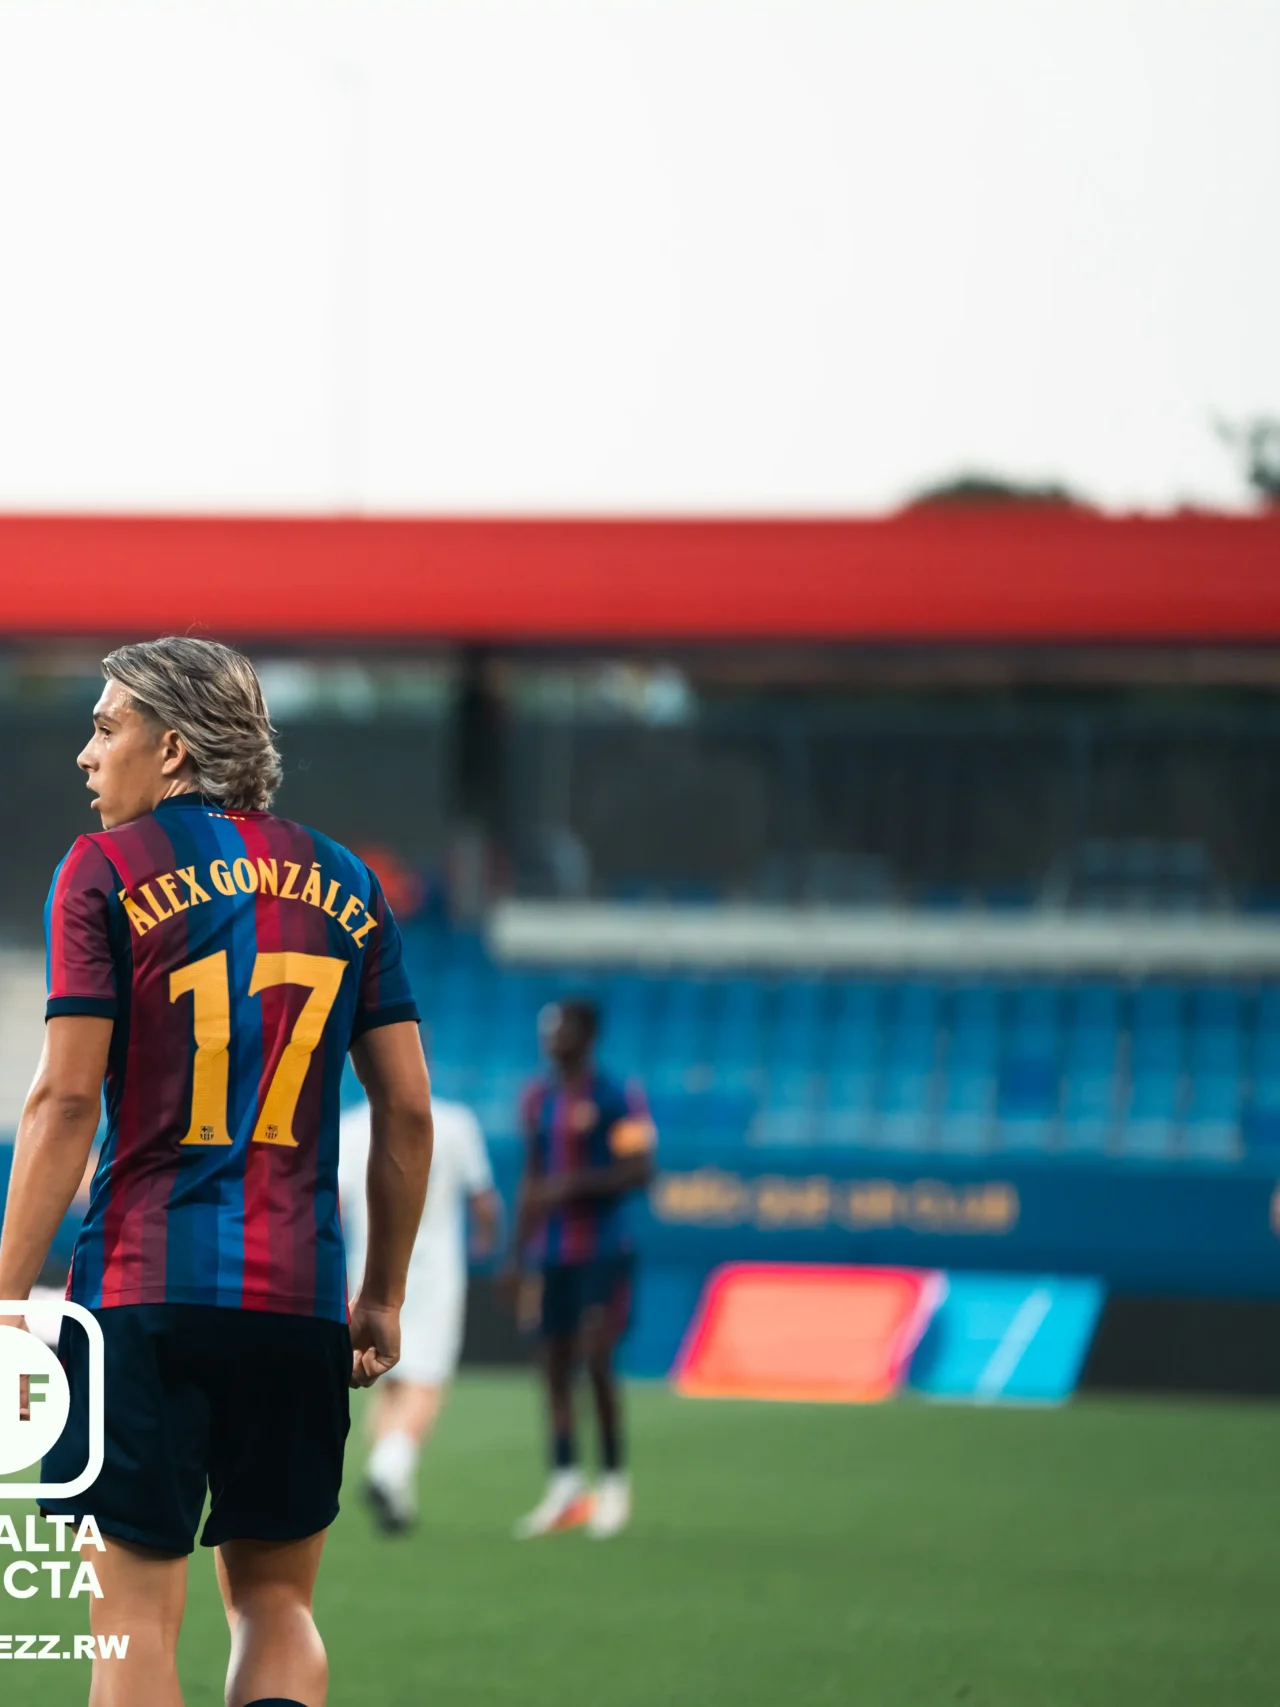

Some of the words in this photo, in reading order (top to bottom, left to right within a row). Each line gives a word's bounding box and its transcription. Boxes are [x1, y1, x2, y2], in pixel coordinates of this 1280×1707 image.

[118, 865, 212, 937] ÁLEX
[210, 857, 378, 948] GONZÁLEZ
[169, 949, 350, 1147] 17
